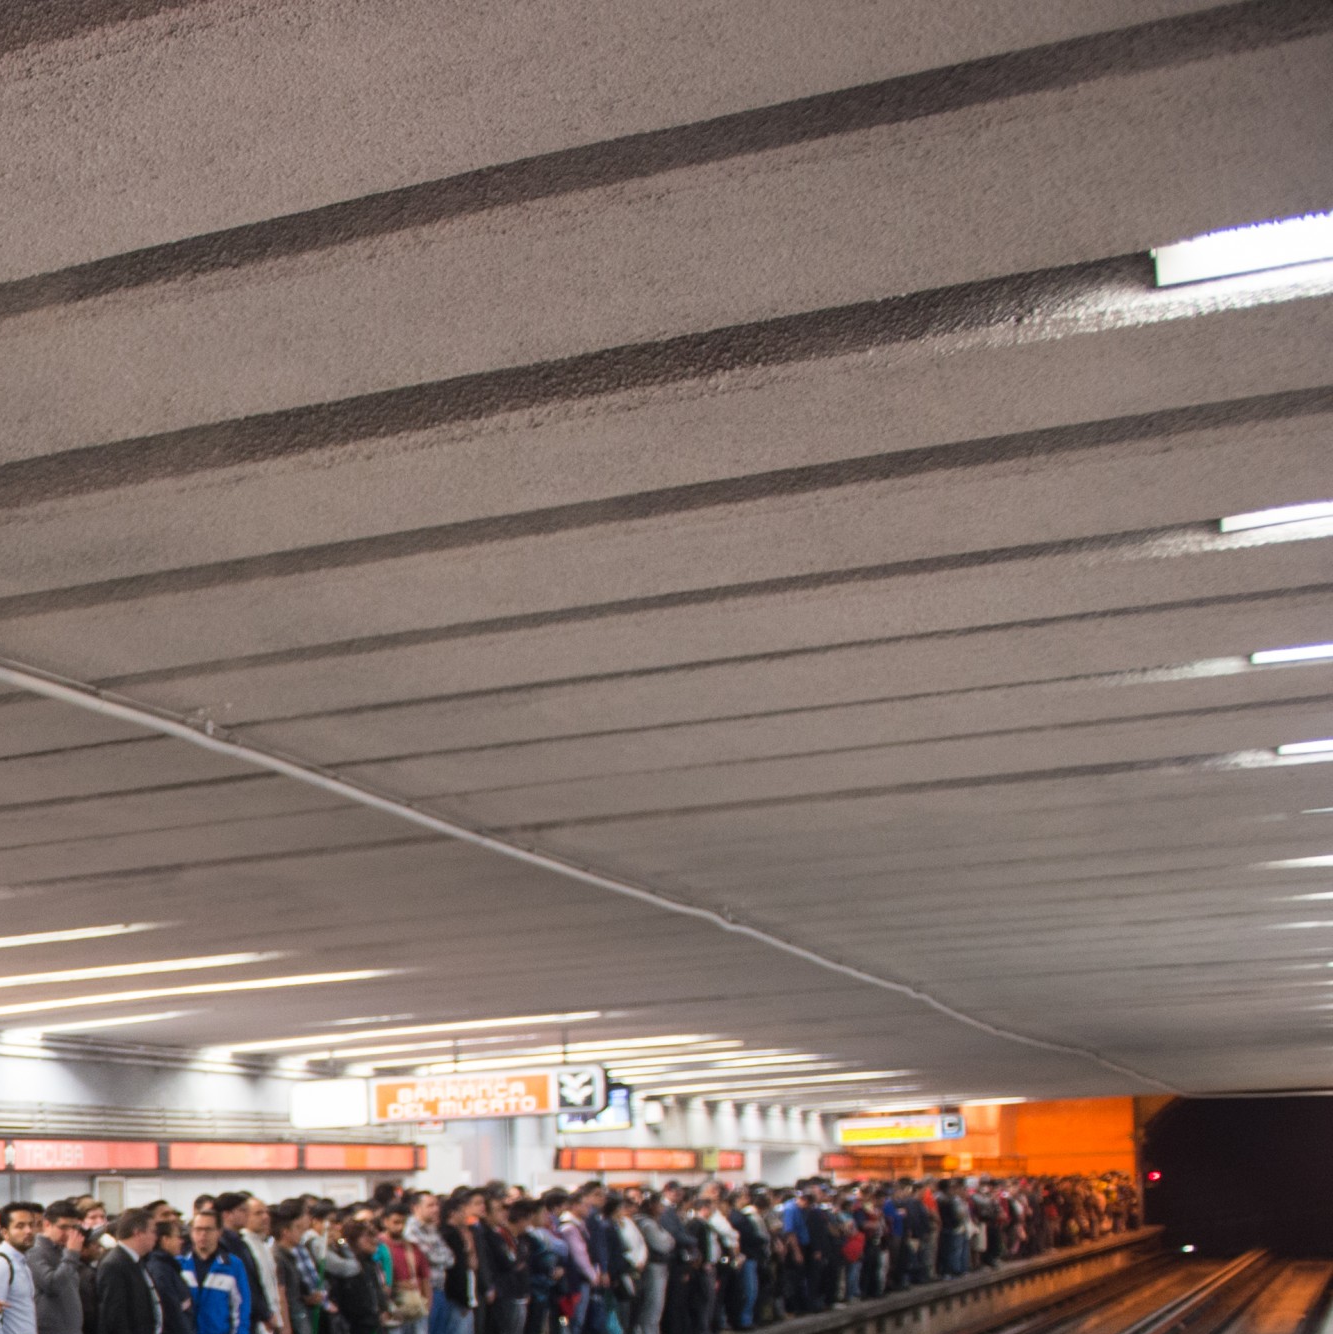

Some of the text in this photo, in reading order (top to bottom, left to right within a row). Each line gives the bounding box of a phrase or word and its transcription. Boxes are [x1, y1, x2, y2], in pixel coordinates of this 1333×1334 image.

[396, 1080, 527, 1104] BARRANCA
[386, 1095, 537, 1119] DEL MUERTO
[22, 1144, 85, 1168] TACUBA
